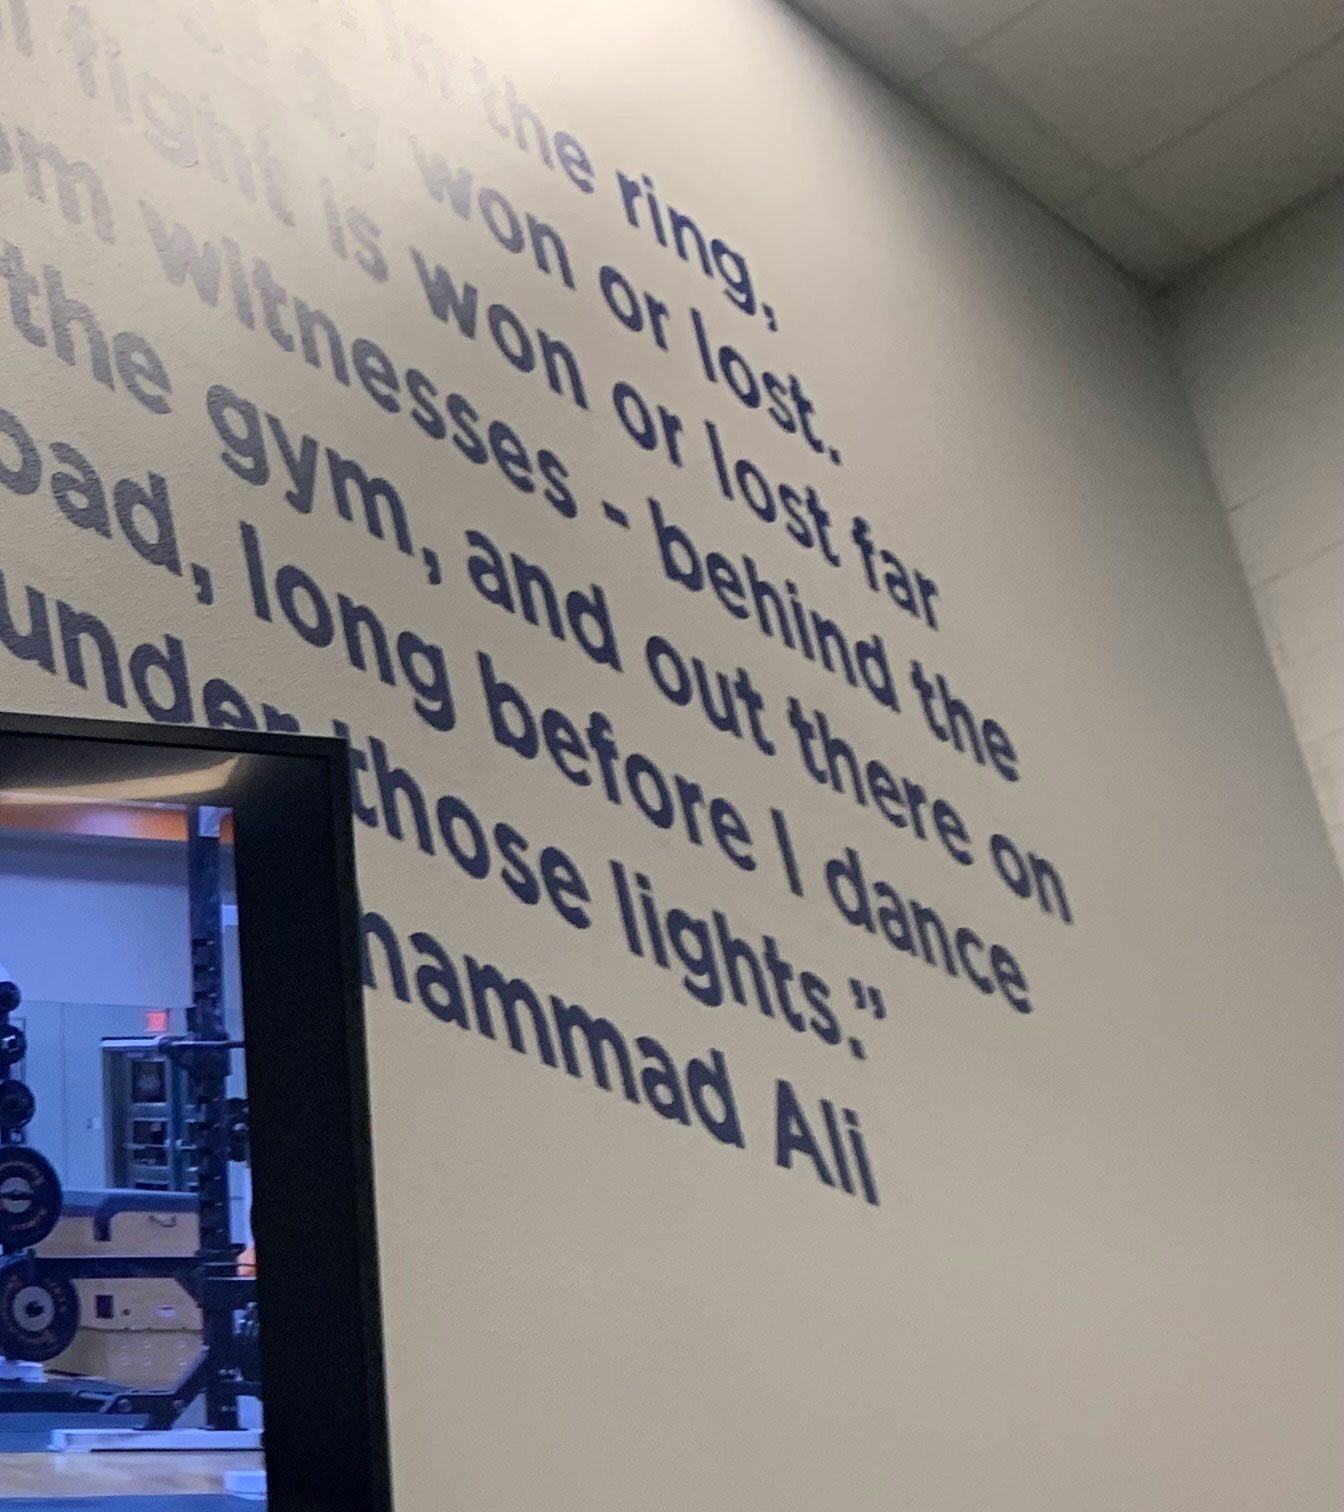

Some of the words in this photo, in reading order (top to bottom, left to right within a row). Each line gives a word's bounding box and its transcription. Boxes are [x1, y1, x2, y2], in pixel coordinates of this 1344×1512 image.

[407, 130, 576, 290] won
[599, 265, 669, 350] or
[691, 307, 841, 466] lost.
[470, 57, 595, 194] the
[615, 168, 778, 332] ring,
[137, 199, 579, 520] witnesses
[648, 497, 900, 712] behind
[909, 660, 1020, 782] the
[317, 174, 389, 283] is
[409, 245, 590, 410] won
[610, 381, 683, 467] or
[705, 419, 841, 567] lost
[850, 516, 940, 630] far
[206, 384, 443, 585] gym,
[465, 530, 623, 672] and
[644, 634, 777, 757] out
[788, 697, 974, 867] there
[989, 831, 1075, 926] on
[238, 521, 458, 732] long
[477, 650, 758, 873] before
[769, 808, 807, 897] I
[825, 848, 1034, 1015] dance
[332, 718, 593, 930] those
[772, 1078, 880, 1206] Ali
